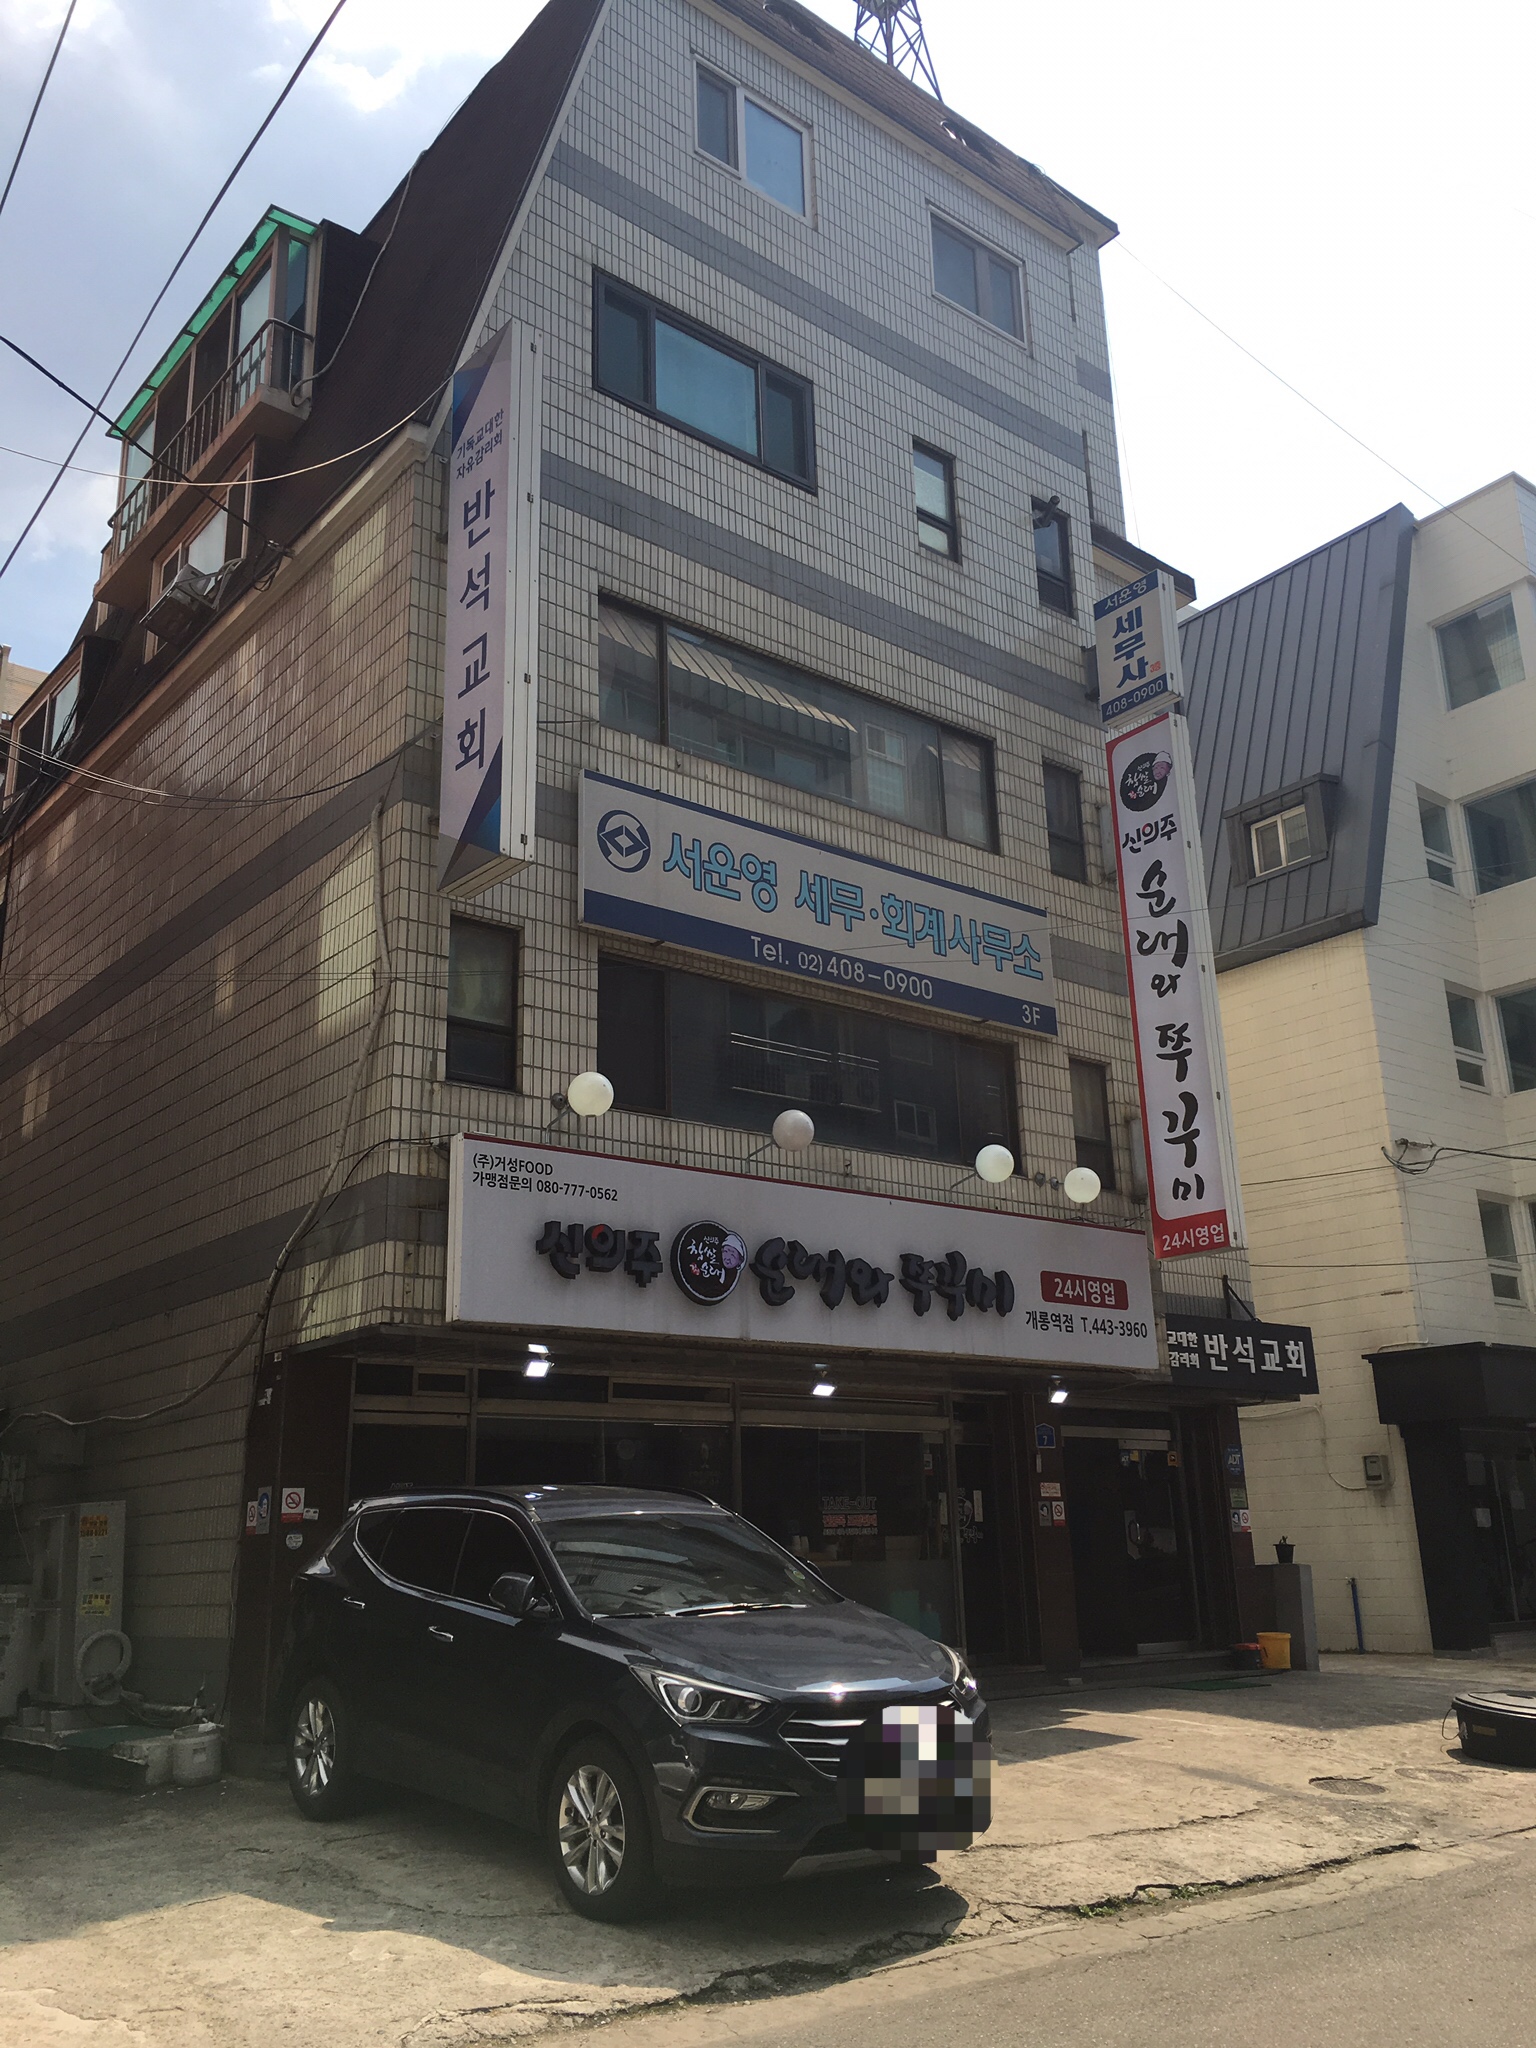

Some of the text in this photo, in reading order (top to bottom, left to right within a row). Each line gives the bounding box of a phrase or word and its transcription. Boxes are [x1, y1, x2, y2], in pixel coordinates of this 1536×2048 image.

[456, 408, 504, 460] 기독교대한
[456, 429, 503, 480] 자유감리회
[1104, 578, 1148, 610] 서운영
[454, 478, 496, 771] 반석교회
[1112, 605, 1149, 689] 세무사
[1105, 680, 1164, 717] 408-0900
[1121, 813, 1178, 855] 신의주
[662, 831, 779, 915] 서운영
[1135, 858, 1190, 999] 순대와
[750, 935, 790, 966] Tel.
[1021, 1004, 1042, 1027] 3F
[472, 1152, 554, 1177] (주)거성FOOD
[472, 1171, 619, 1203] 가맹점문의 080-777-0562
[703, 1235, 720, 1246] 신의주
[1161, 1222, 1226, 1253] 24시영업
[535, 1220, 664, 1289] 신의주
[699, 1261, 727, 1285] 순대
[749, 1236, 895, 1311] 순대와
[1053, 1276, 1117, 1306] 24시영업
[1025, 1310, 1149, 1340] 개롱역점 T.443-3960
[1168, 1351, 1200, 1369] 감리회
[1203, 1332, 1308, 1379] 반석교회
[1042, 1435, 1048, 1446] 7
[1227, 1453, 1241, 1465] ADT
[821, 1496, 878, 1510] TAKE-OUT
